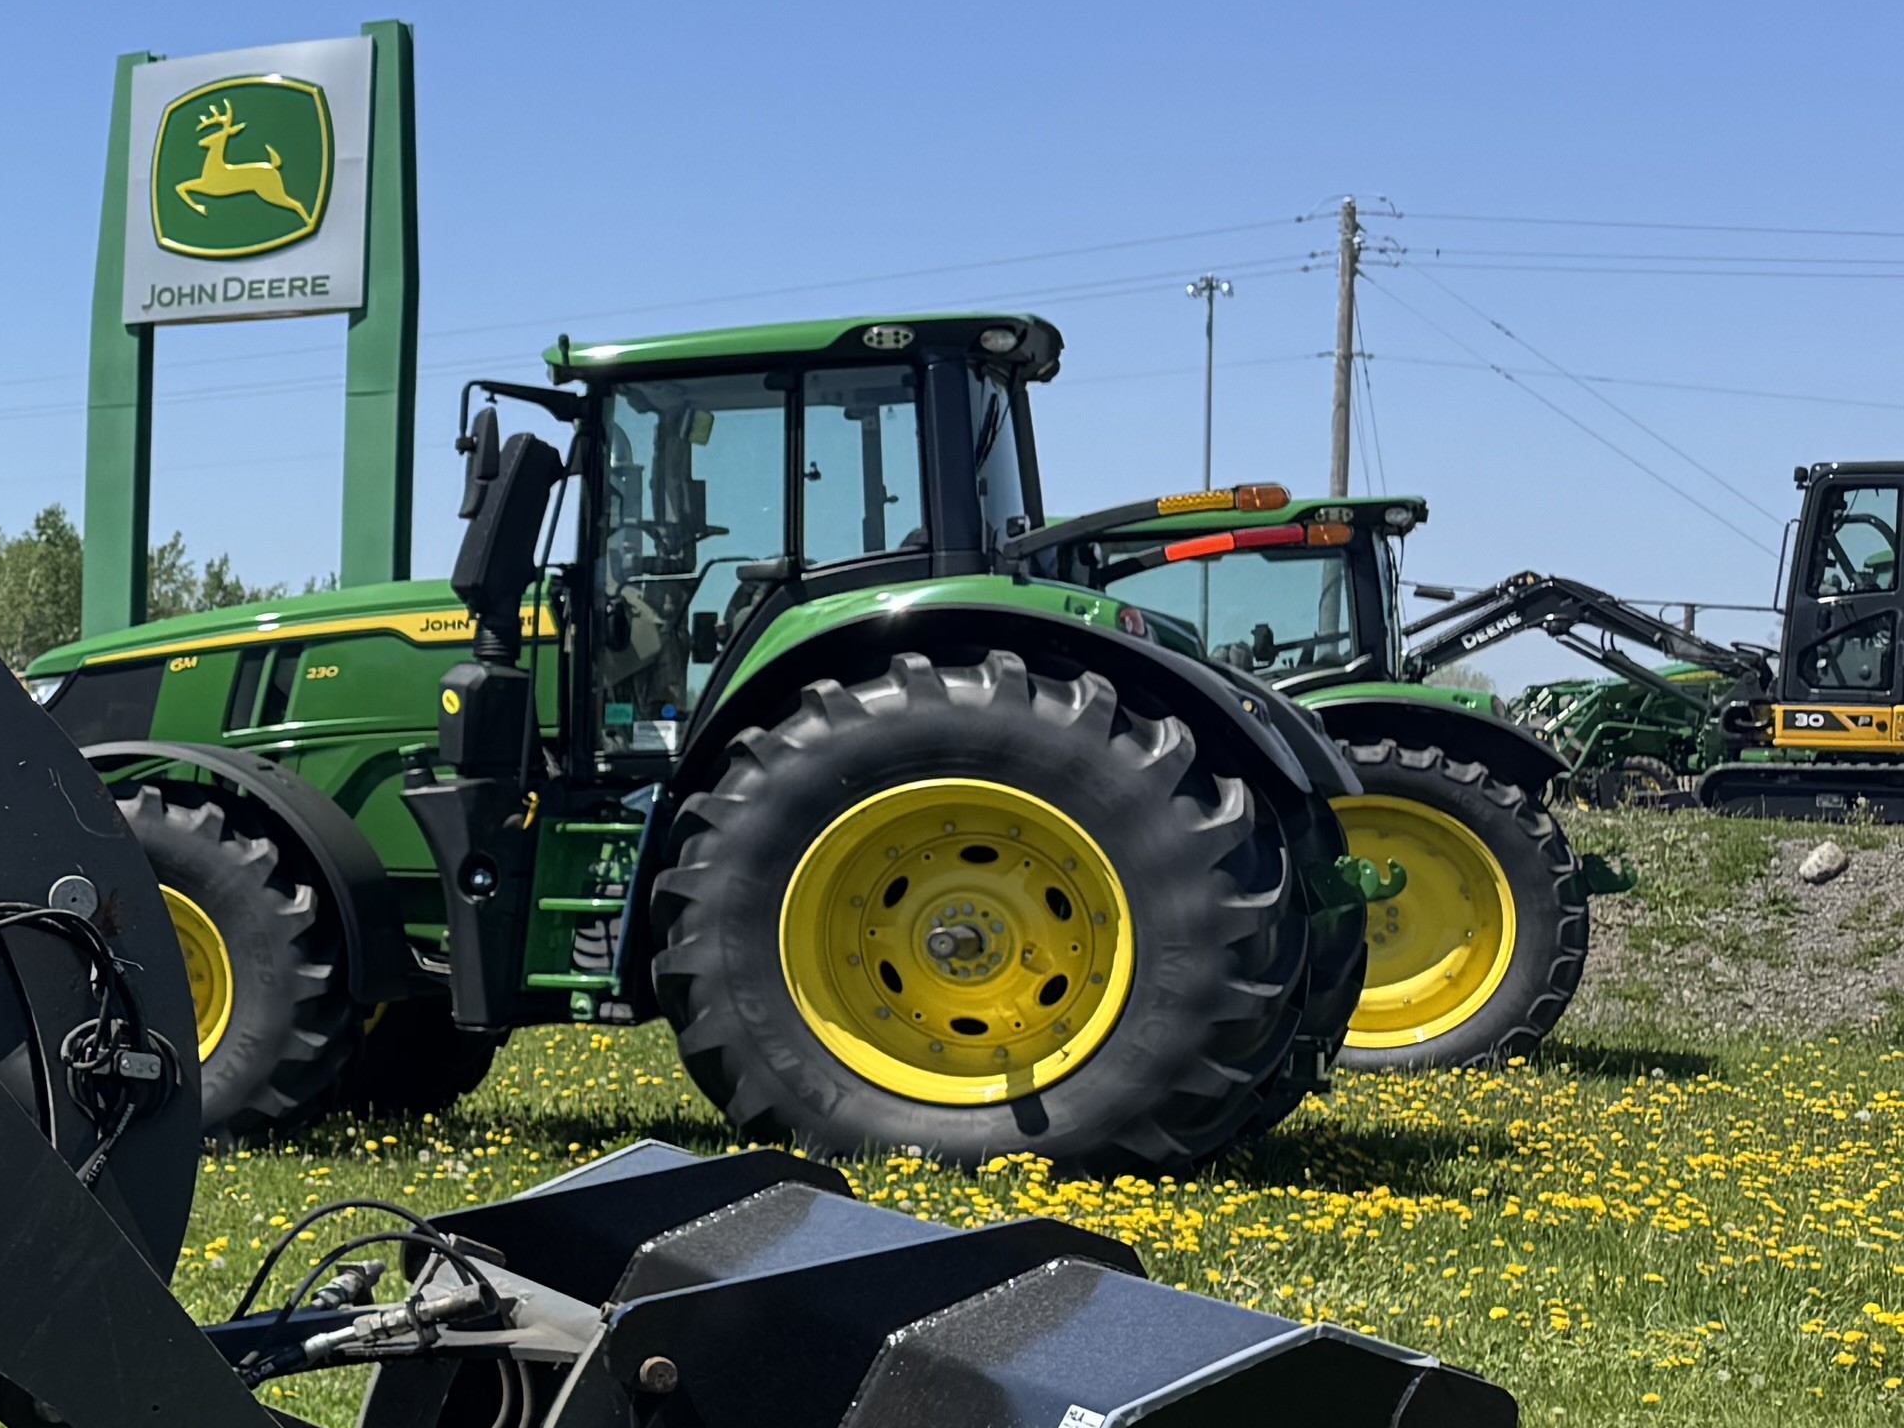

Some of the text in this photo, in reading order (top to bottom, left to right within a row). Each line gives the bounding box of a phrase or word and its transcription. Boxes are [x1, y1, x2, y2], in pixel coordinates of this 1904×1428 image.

[141, 274, 331, 312] JOHN DEERE
[420, 618, 470, 632] JOHN
[1460, 610, 1522, 650] DEERE
[169, 655, 200, 672] 6M
[305, 665, 340, 680] 230
[1794, 712, 1825, 728] 30
